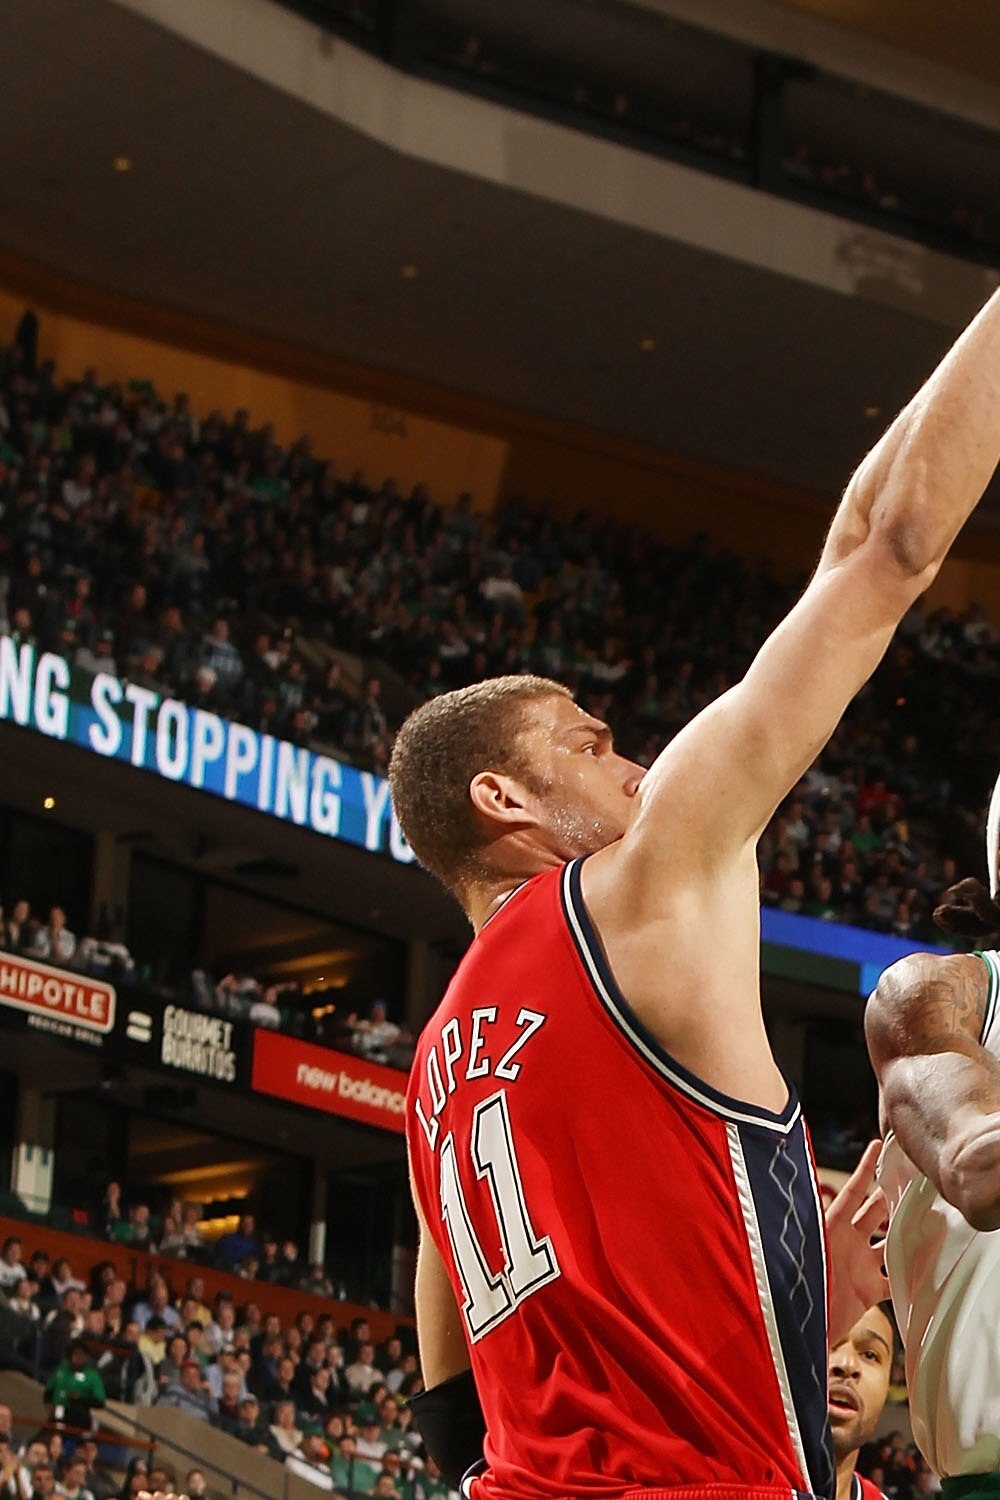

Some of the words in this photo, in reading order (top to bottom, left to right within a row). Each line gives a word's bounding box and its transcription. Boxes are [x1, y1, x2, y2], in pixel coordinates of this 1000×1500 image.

[88, 672, 344, 838] STOPPING
[161, 1033, 237, 1083] BURRITOS
[164, 1004, 233, 1051] GOURMET
[297, 1063, 337, 1093] new
[338, 1071, 407, 1115] balanc
[415, 1006, 546, 1152] LOPEZ
[439, 1087, 561, 1345] 11
